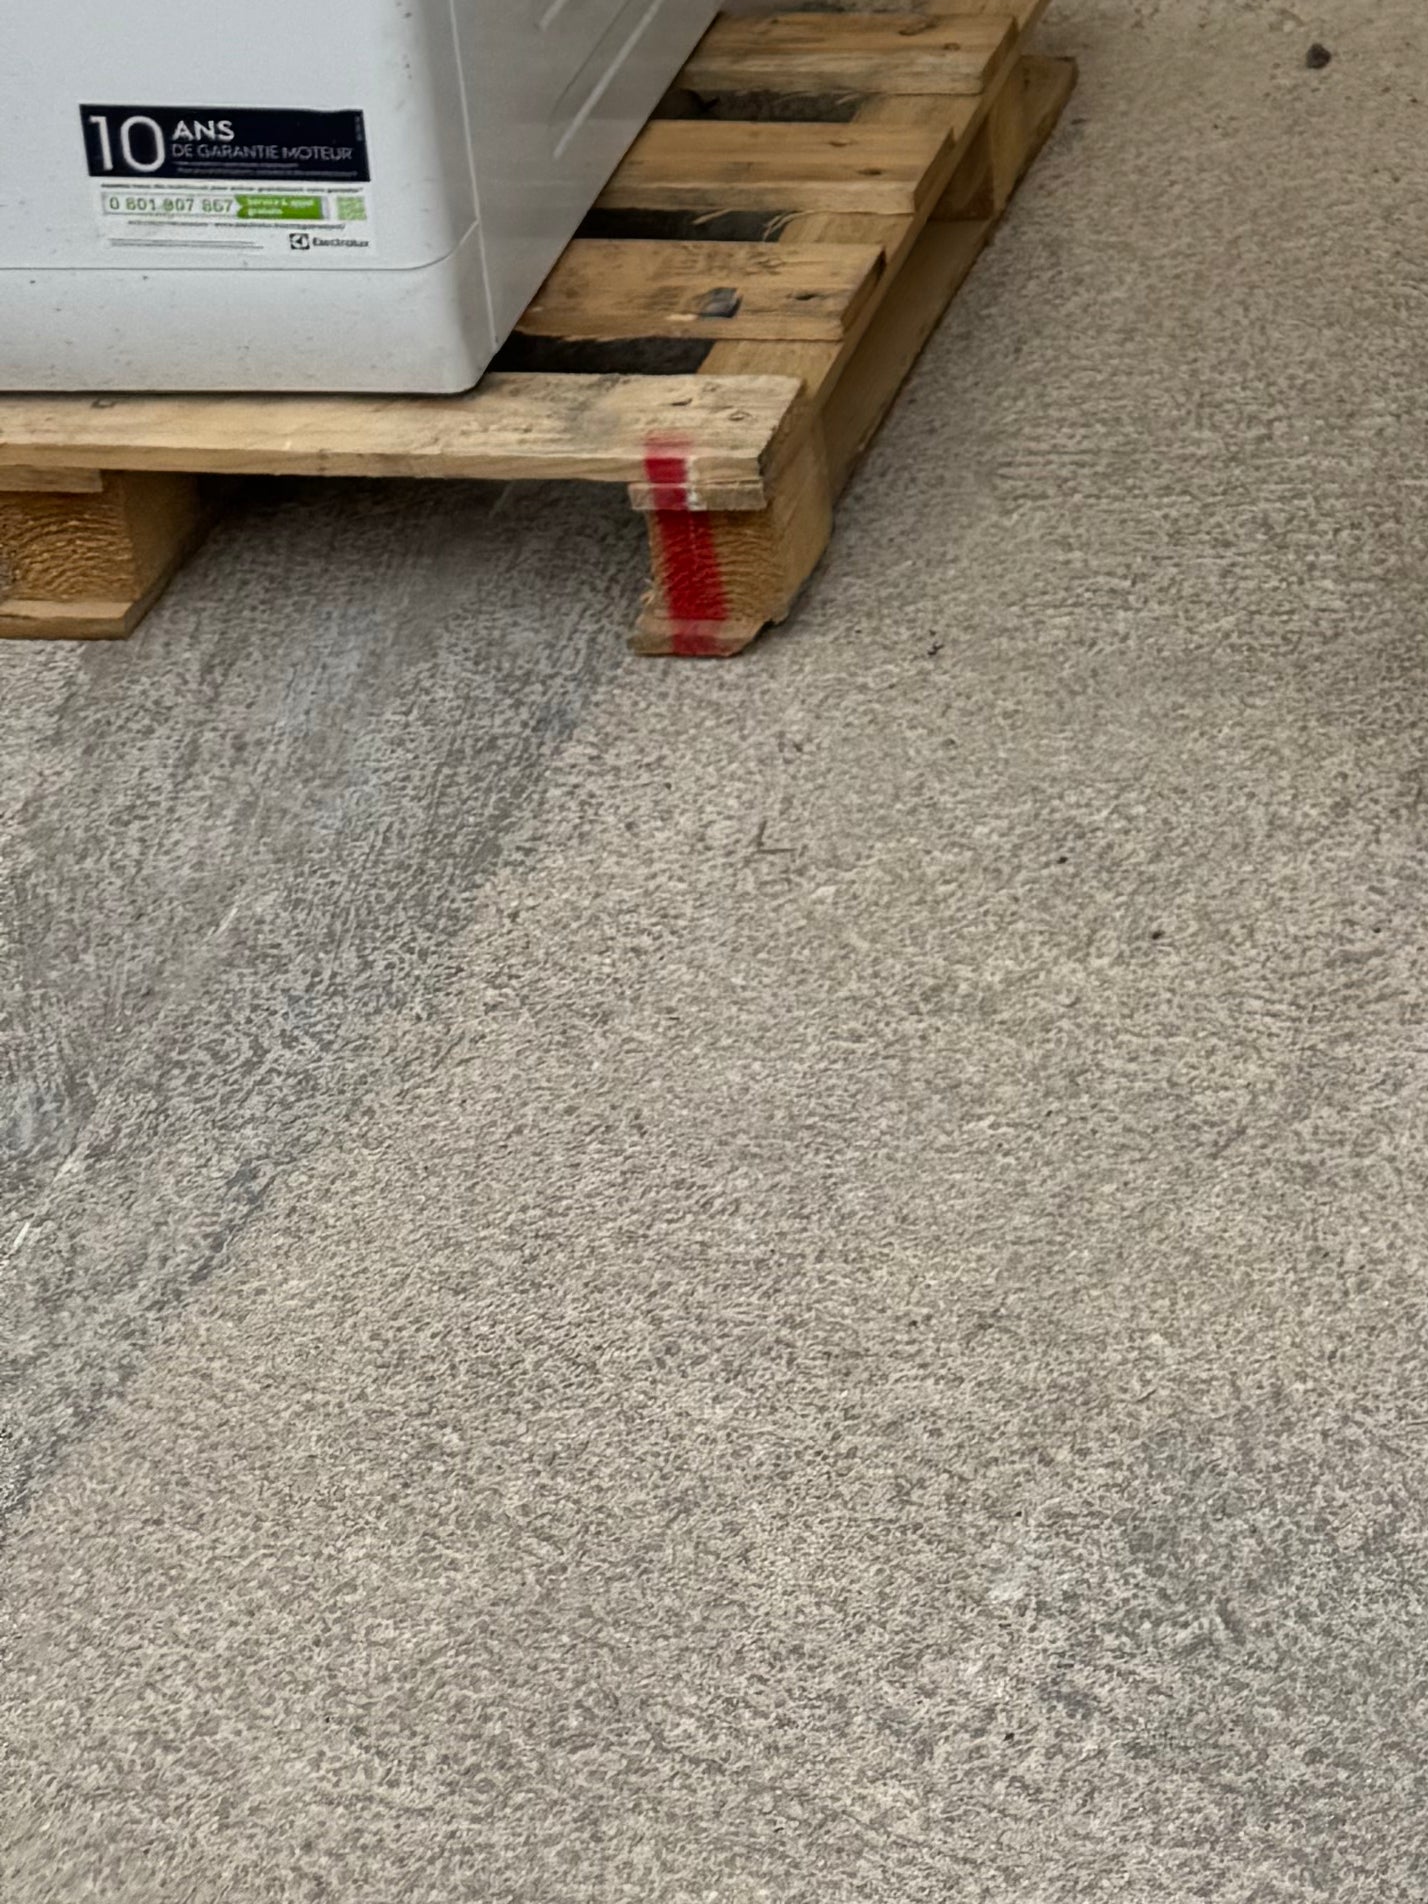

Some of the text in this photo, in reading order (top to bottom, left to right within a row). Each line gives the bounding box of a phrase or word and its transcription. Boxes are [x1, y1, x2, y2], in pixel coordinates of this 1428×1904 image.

[172, 119, 235, 142] ANS
[89, 114, 166, 173] 10
[172, 143, 354, 161] DE GARANTIE MOTEUR
[109, 196, 120, 210] 0
